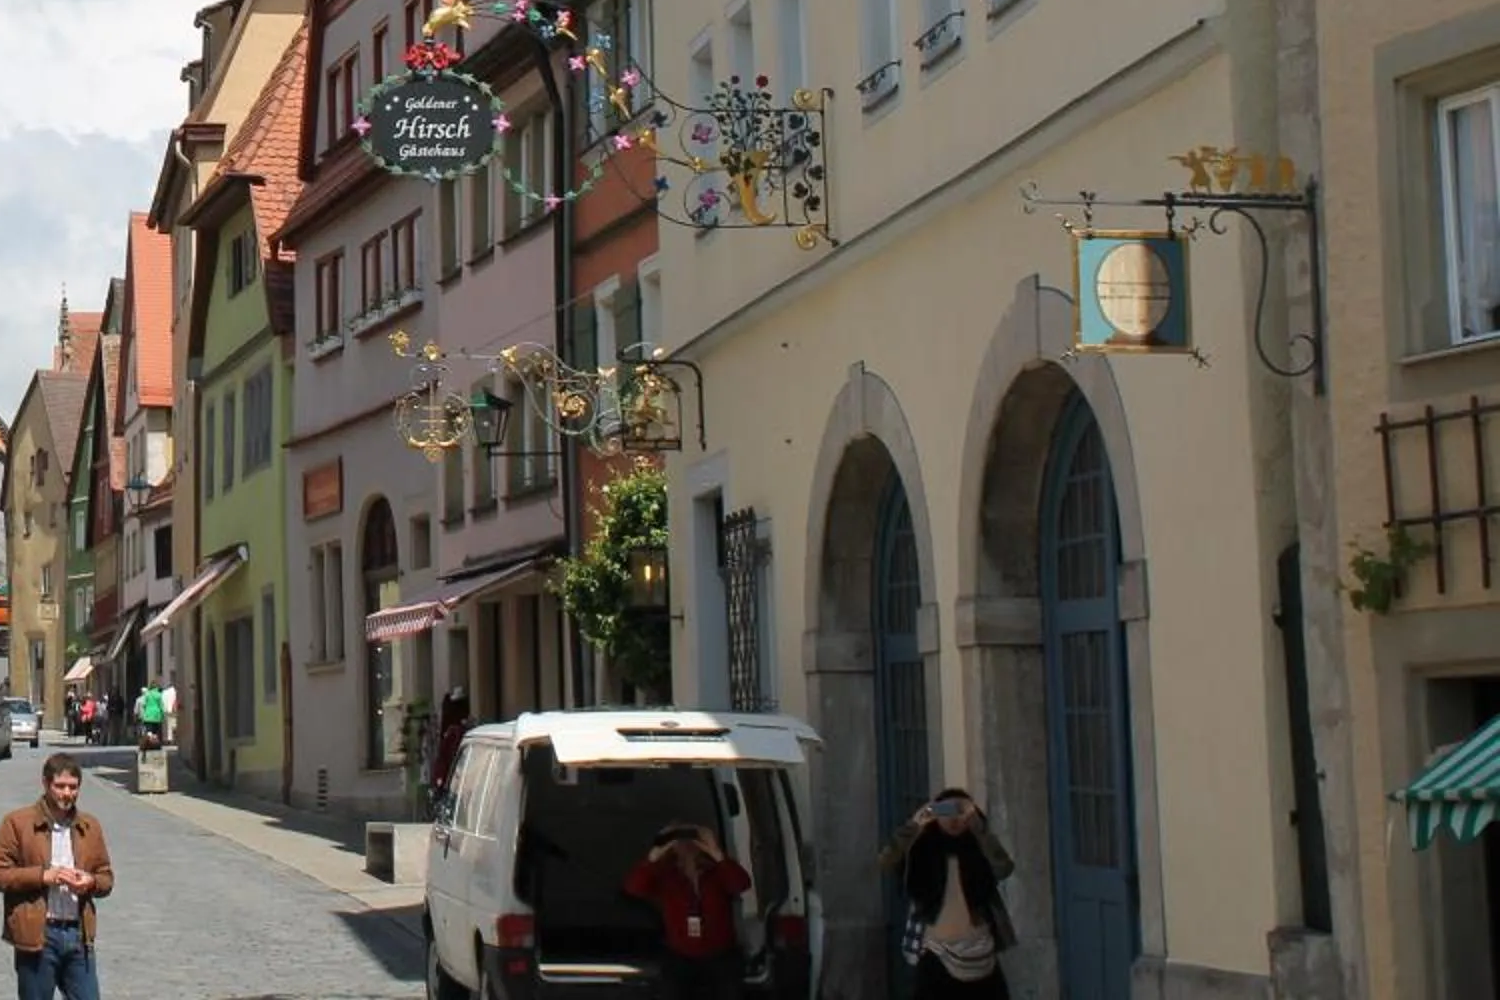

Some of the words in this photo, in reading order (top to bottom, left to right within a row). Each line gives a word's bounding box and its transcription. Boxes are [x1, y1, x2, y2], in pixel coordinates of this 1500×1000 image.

[404, 96, 459, 112] Goldener
[393, 115, 472, 139] Hirsch
[399, 143, 467, 160] Gästehaus
